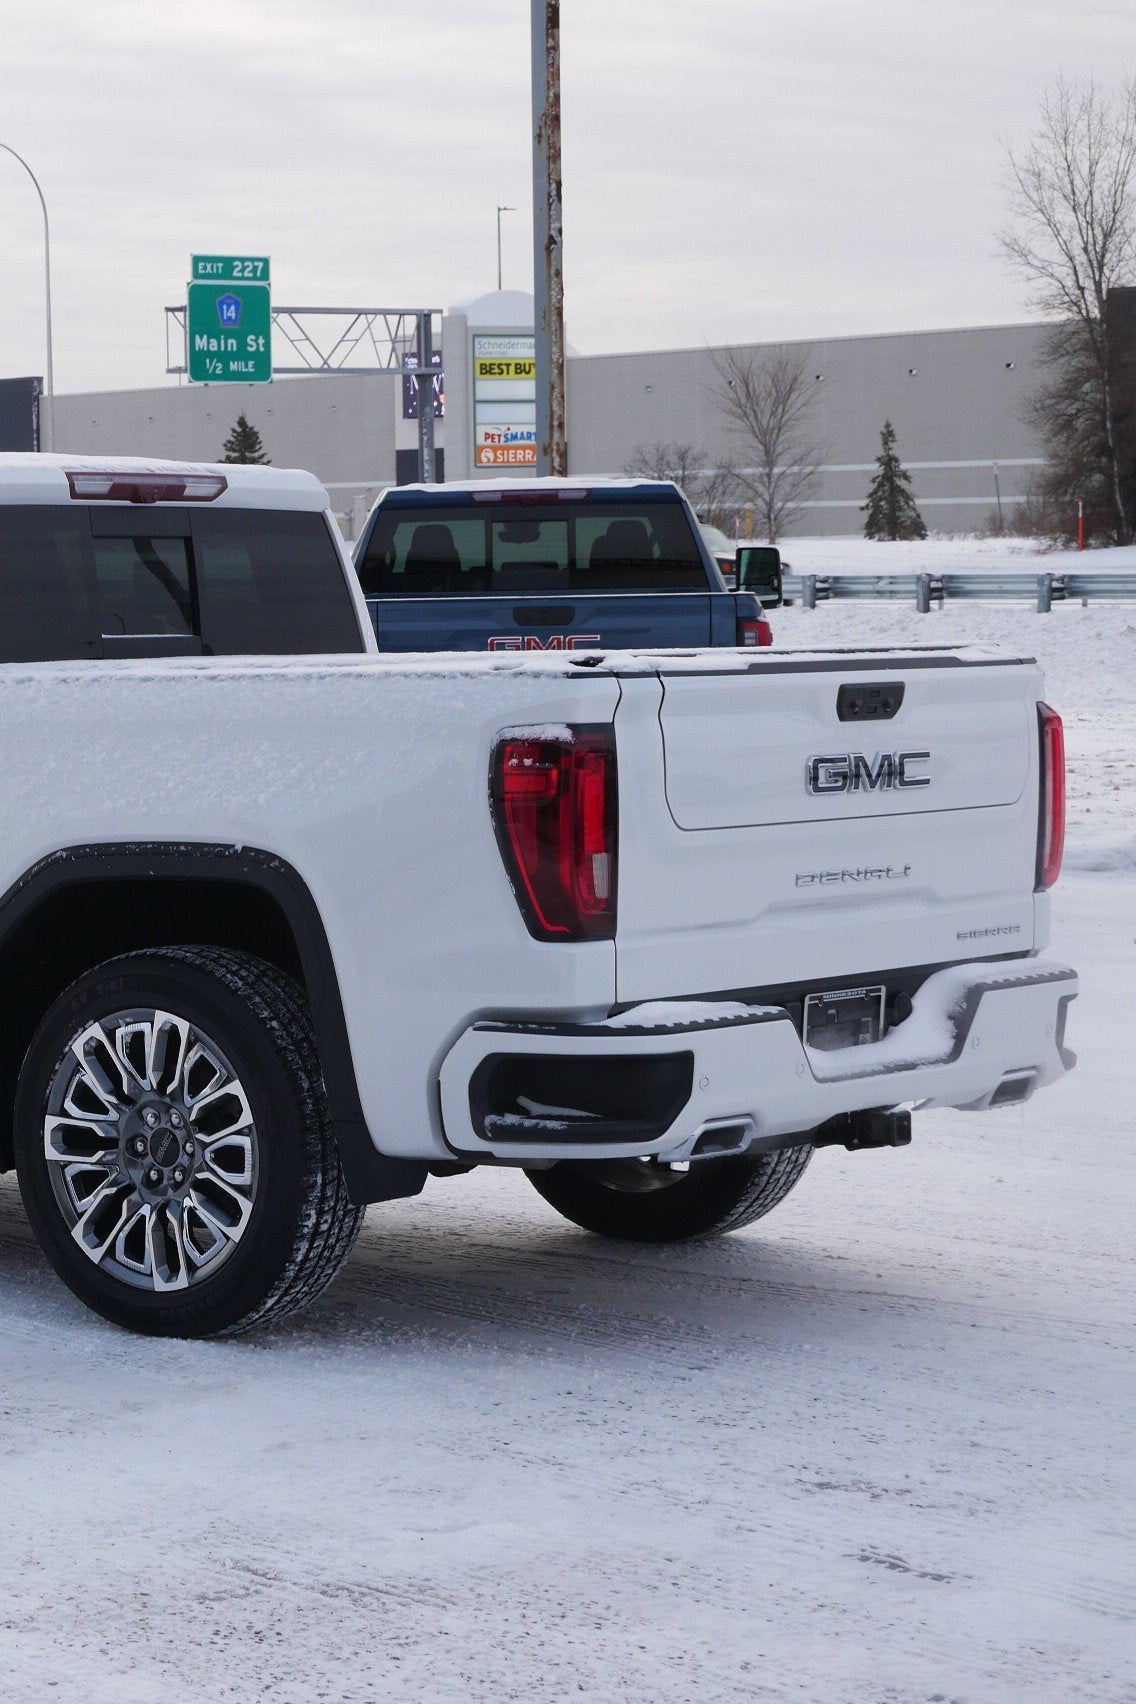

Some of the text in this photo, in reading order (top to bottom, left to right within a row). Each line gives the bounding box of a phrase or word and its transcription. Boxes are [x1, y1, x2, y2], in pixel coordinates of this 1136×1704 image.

[198, 261, 264, 277] EXIT 227
[222, 304, 237, 320] 14
[195, 334, 266, 352] Main St
[477, 340, 535, 350] Schneiderma
[230, 361, 256, 372] MILE
[479, 362, 511, 375] BEST
[496, 449, 536, 462] SIERR
[488, 635, 600, 651] GMC
[805, 750, 931, 796] GMC
[795, 863, 911, 887] DENALI
[956, 924, 1021, 940] SIERRA
[822, 989, 866, 1000] MINNESOTA
